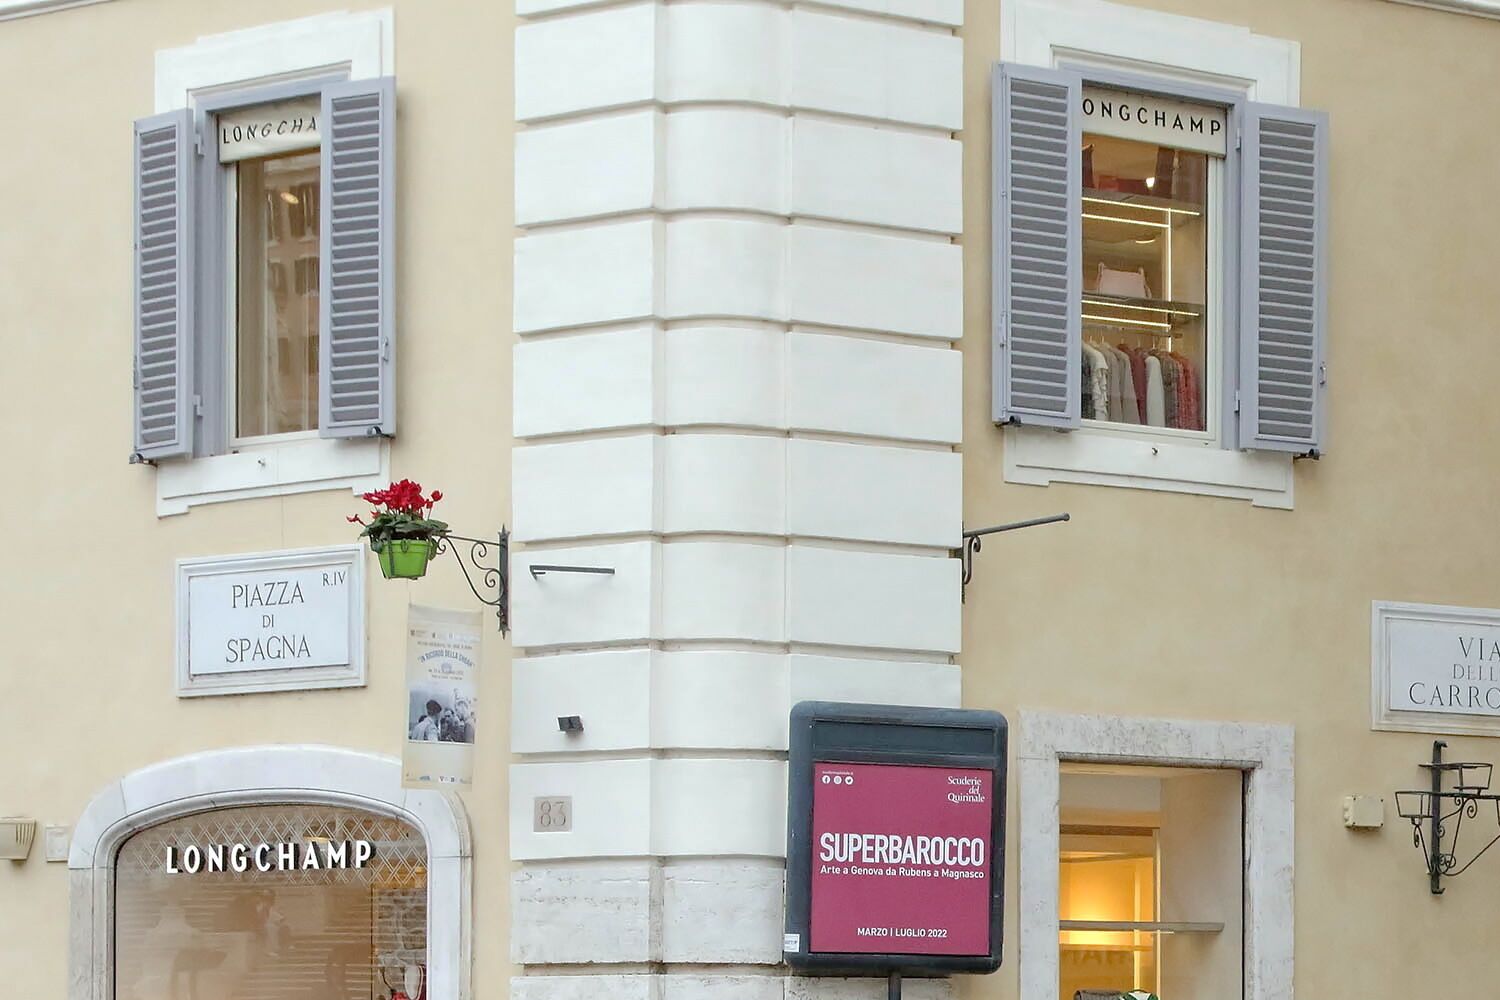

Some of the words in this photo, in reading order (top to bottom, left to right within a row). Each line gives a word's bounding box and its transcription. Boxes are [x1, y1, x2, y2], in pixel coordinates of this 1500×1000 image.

[223, 116, 317, 144] LONGCHA
[1082, 98, 1221, 135] ONGCHAMP
[232, 581, 305, 608] PIAZZA
[262, 614, 274, 628] DI
[226, 634, 311, 663] SPAGNA
[947, 776, 982, 786] Scuderie
[968, 785, 980, 794] del
[947, 793, 986, 803] Quirinale
[540, 800, 566, 827] 83
[166, 840, 374, 874] LONGCHAMP
[820, 832, 984, 867] SUPERBAROCCO
[820, 865, 840, 874] Arte
[851, 865, 884, 876] Genova
[885, 867, 897, 876] da
[900, 867, 932, 878] Rubens
[933, 870, 939, 878] a
[942, 869, 984, 880] Magnasco
[857, 927, 888, 937] MARZO
[895, 927, 926, 938] LUGLIO
[927, 928, 948, 938] 2022
